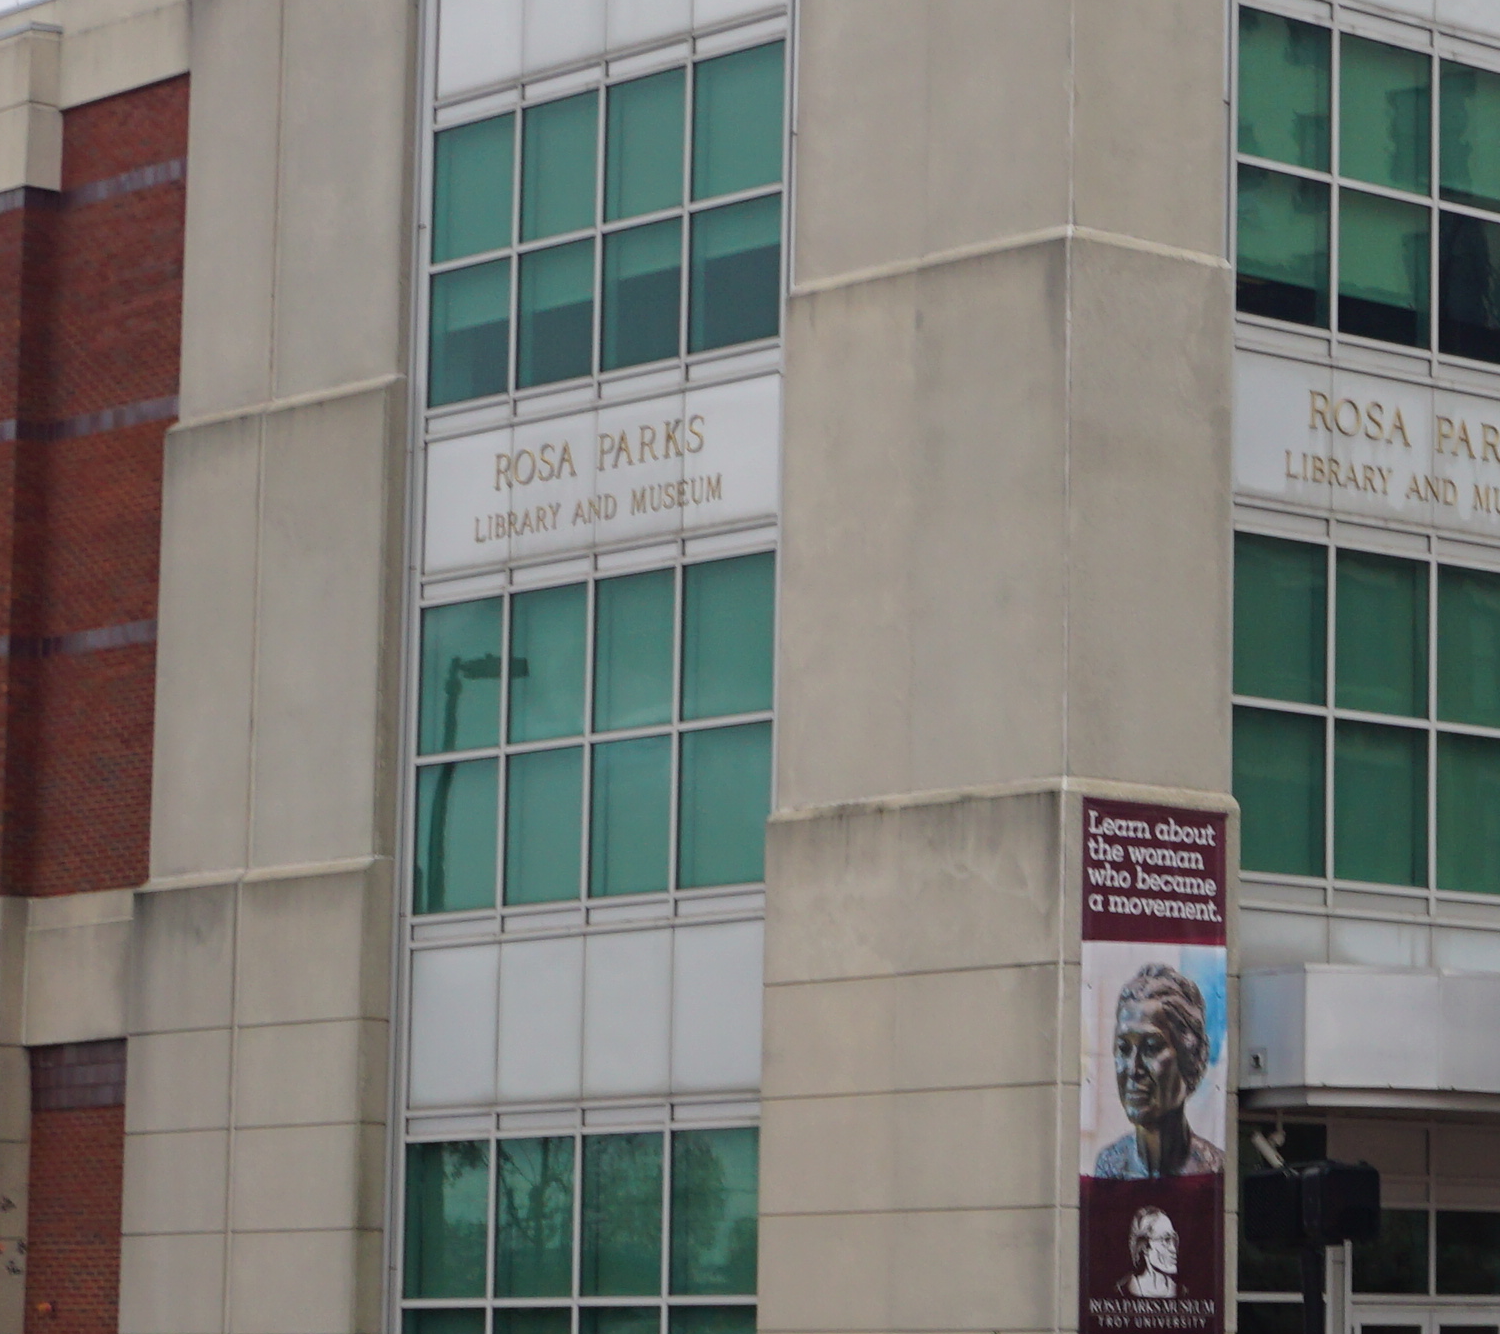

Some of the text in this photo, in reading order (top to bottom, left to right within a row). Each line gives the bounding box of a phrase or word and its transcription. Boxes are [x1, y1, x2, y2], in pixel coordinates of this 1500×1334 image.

[1309, 389, 1412, 448] ROSA
[494, 414, 705, 492] ROSA PARKS
[1285, 449, 1393, 495] LIBRARY
[1405, 472, 1458, 506] AND
[474, 472, 722, 543] LIBRARY AND MUSEUM
[1088, 809, 1216, 846] Learn about
[1087, 835, 1205, 870] the woman
[1087, 861, 1217, 896] who became
[1088, 893, 1222, 922] a movement.
[1089, 1298, 1215, 1315] ROSA PARKS MUSEUM
[1098, 1316, 1207, 1329] TROY UNIVERSITY
